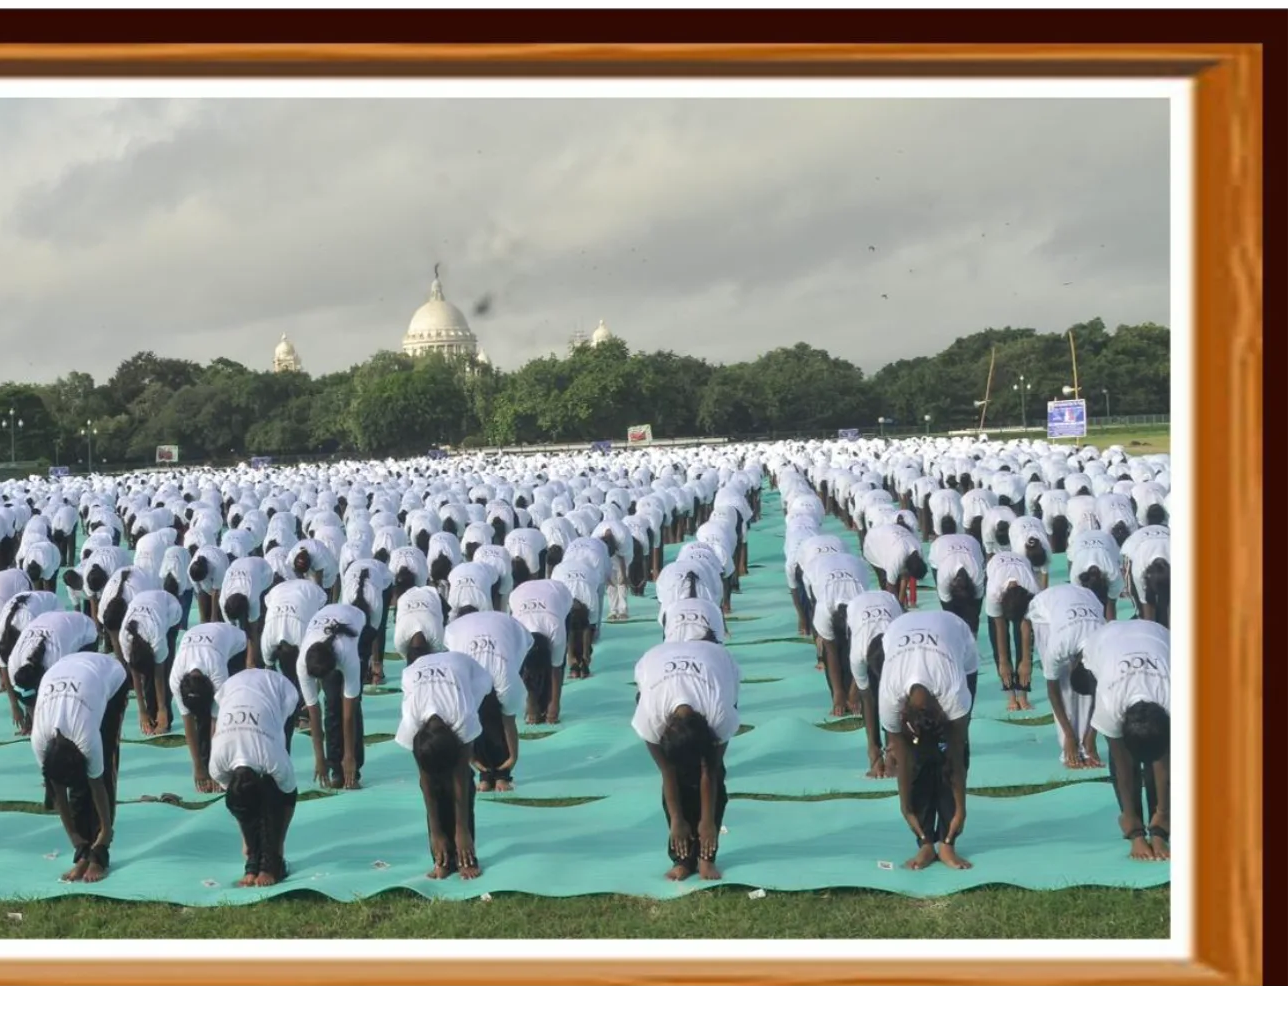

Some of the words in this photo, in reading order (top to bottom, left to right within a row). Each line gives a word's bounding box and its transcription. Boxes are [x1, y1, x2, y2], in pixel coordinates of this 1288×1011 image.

[519, 601, 547, 611] NCC
[1066, 607, 1099, 621] NCC
[184, 635, 215, 645] NCC
[899, 633, 939, 647] NCC
[664, 660, 704, 674] NCC
[1118, 657, 1158, 673] NCC
[412, 668, 447, 682] NCC
[44, 682, 81, 696] NCC
[221, 711, 260, 726] NCC
